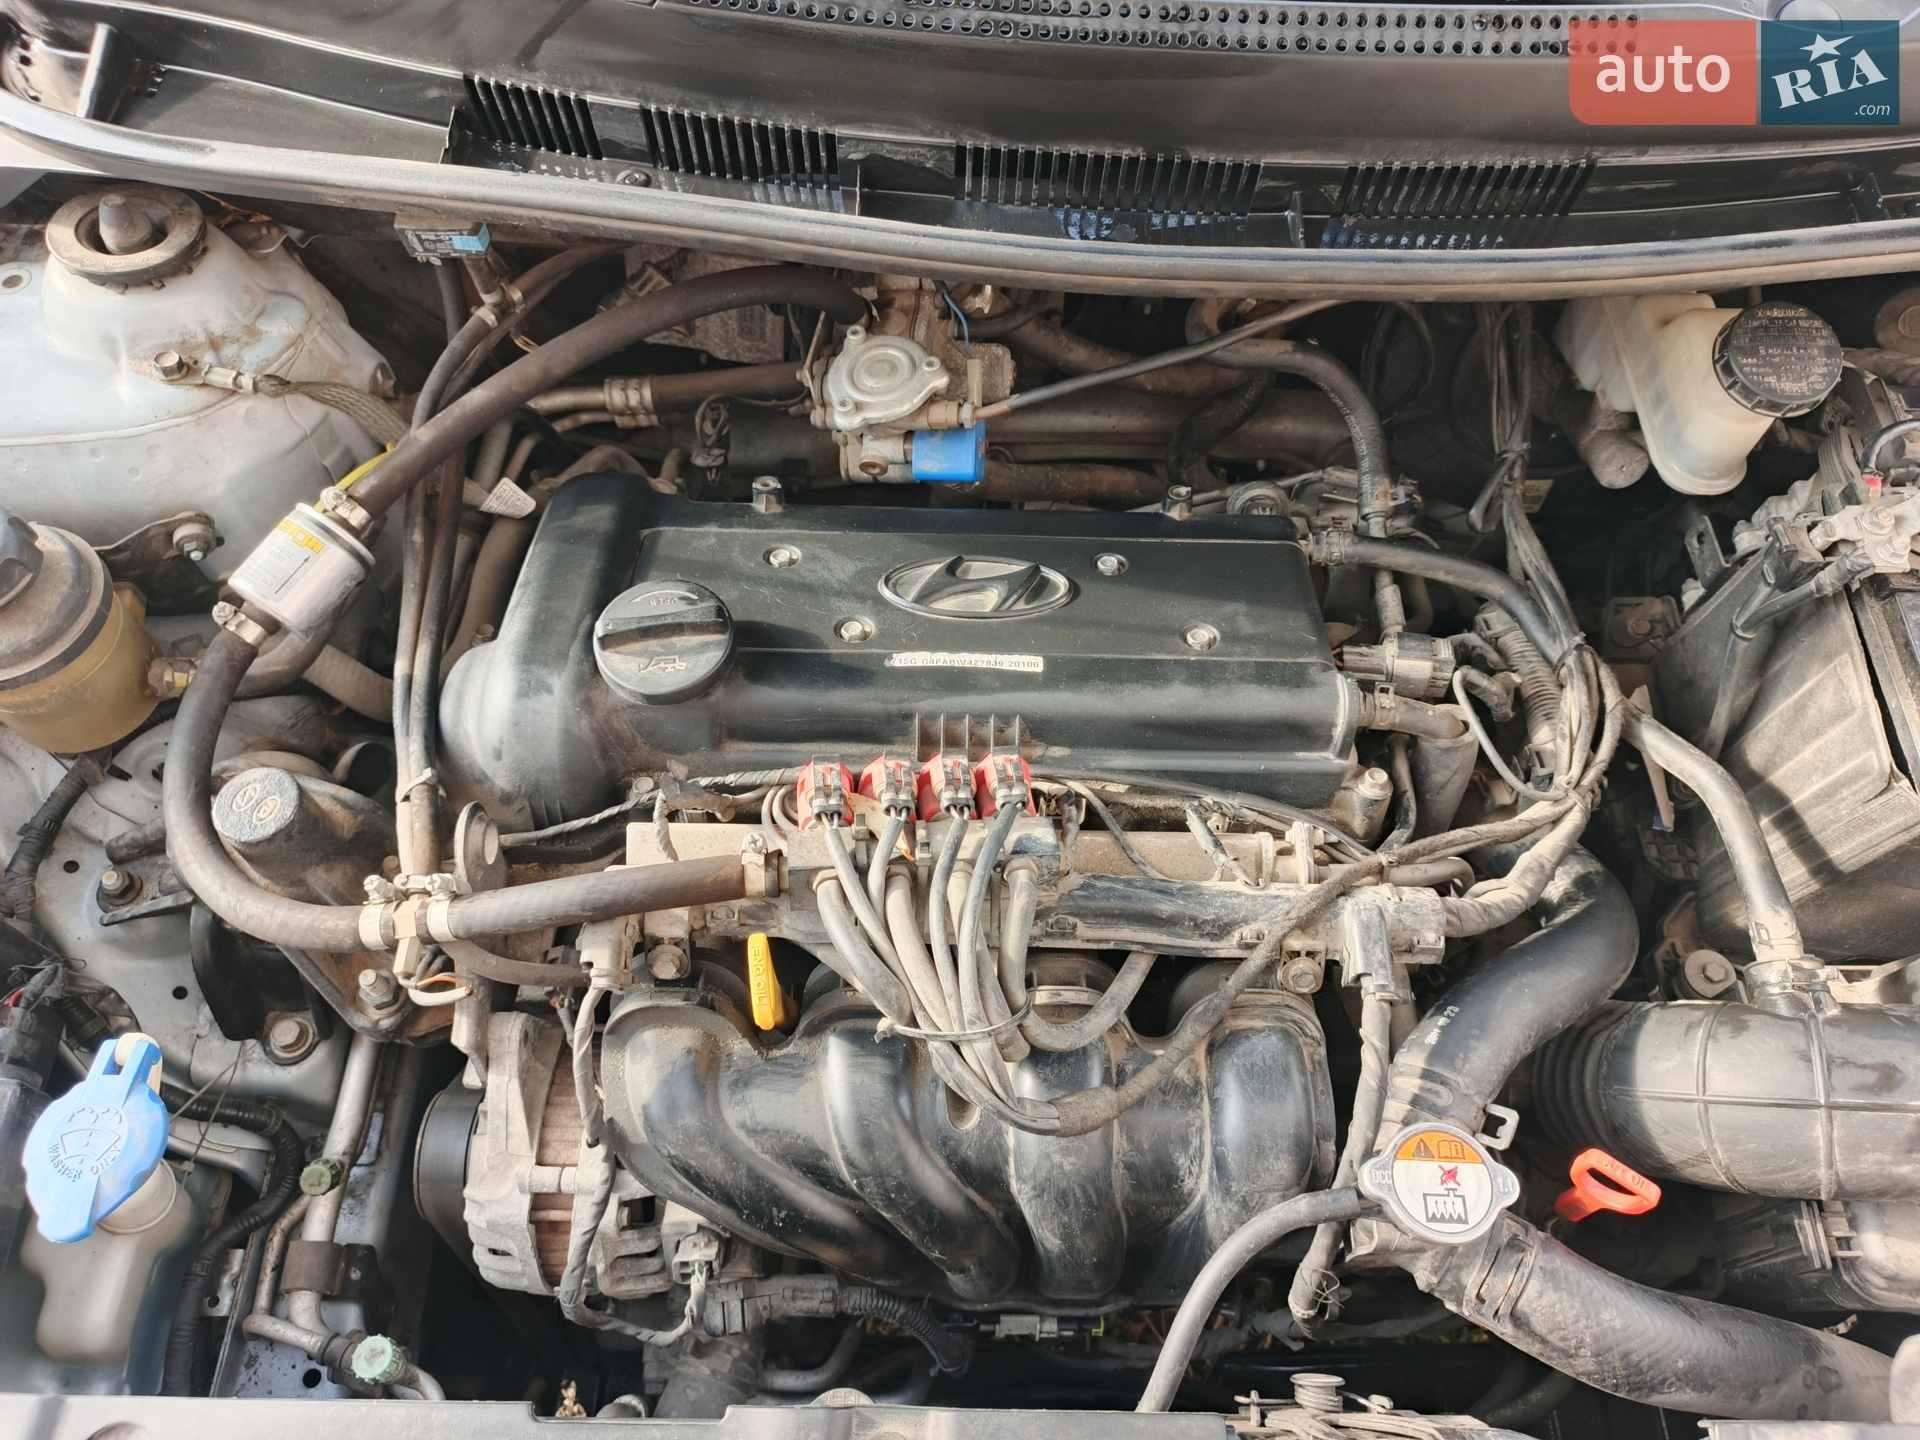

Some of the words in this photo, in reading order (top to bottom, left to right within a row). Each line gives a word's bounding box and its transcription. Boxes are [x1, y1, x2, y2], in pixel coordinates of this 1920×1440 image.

[648, 596, 679, 608] OPEN
[1008, 660, 1039, 669] 20100
[750, 945, 765, 977] ENG
[754, 980, 769, 1007] OIL
[47, 1142, 84, 1183] WASHER
[90, 1144, 121, 1175] ONLY
